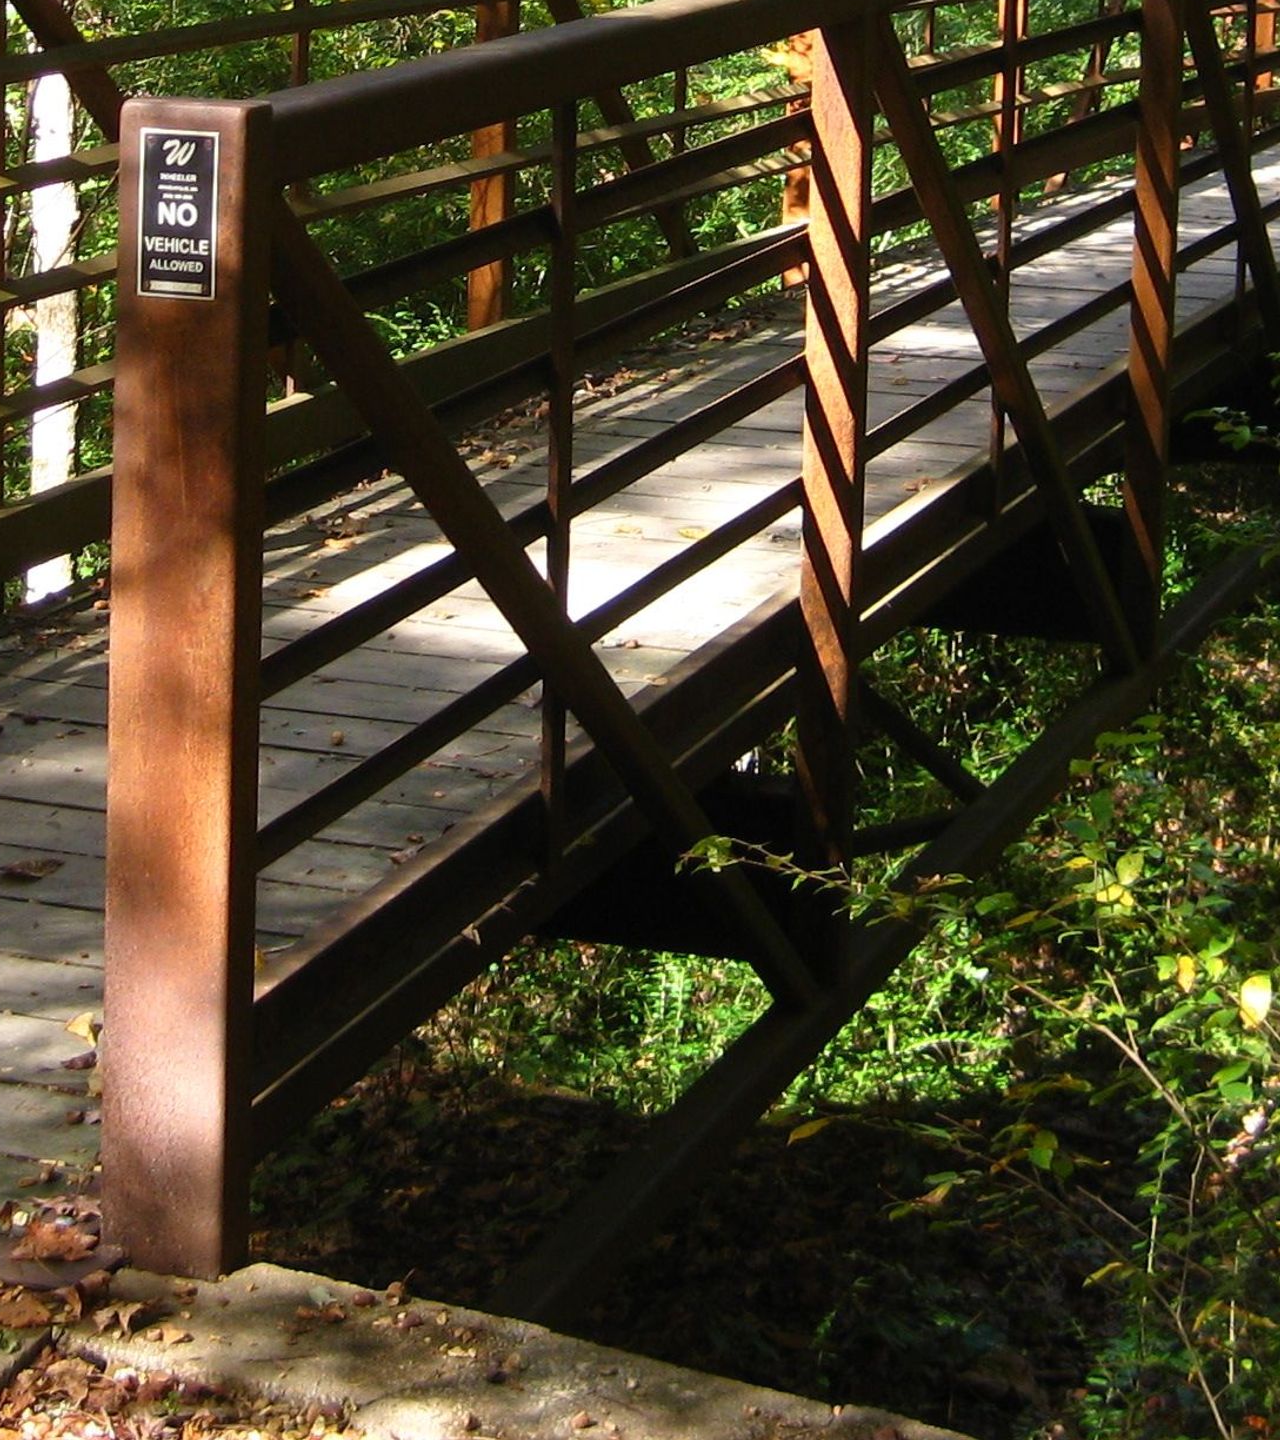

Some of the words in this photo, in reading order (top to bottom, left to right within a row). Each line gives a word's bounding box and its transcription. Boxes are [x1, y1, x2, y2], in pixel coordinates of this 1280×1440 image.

[162, 139, 196, 166] W
[157, 201, 198, 227] NO
[144, 236, 210, 255] VEHICLE
[149, 259, 204, 273] ALLOWED
